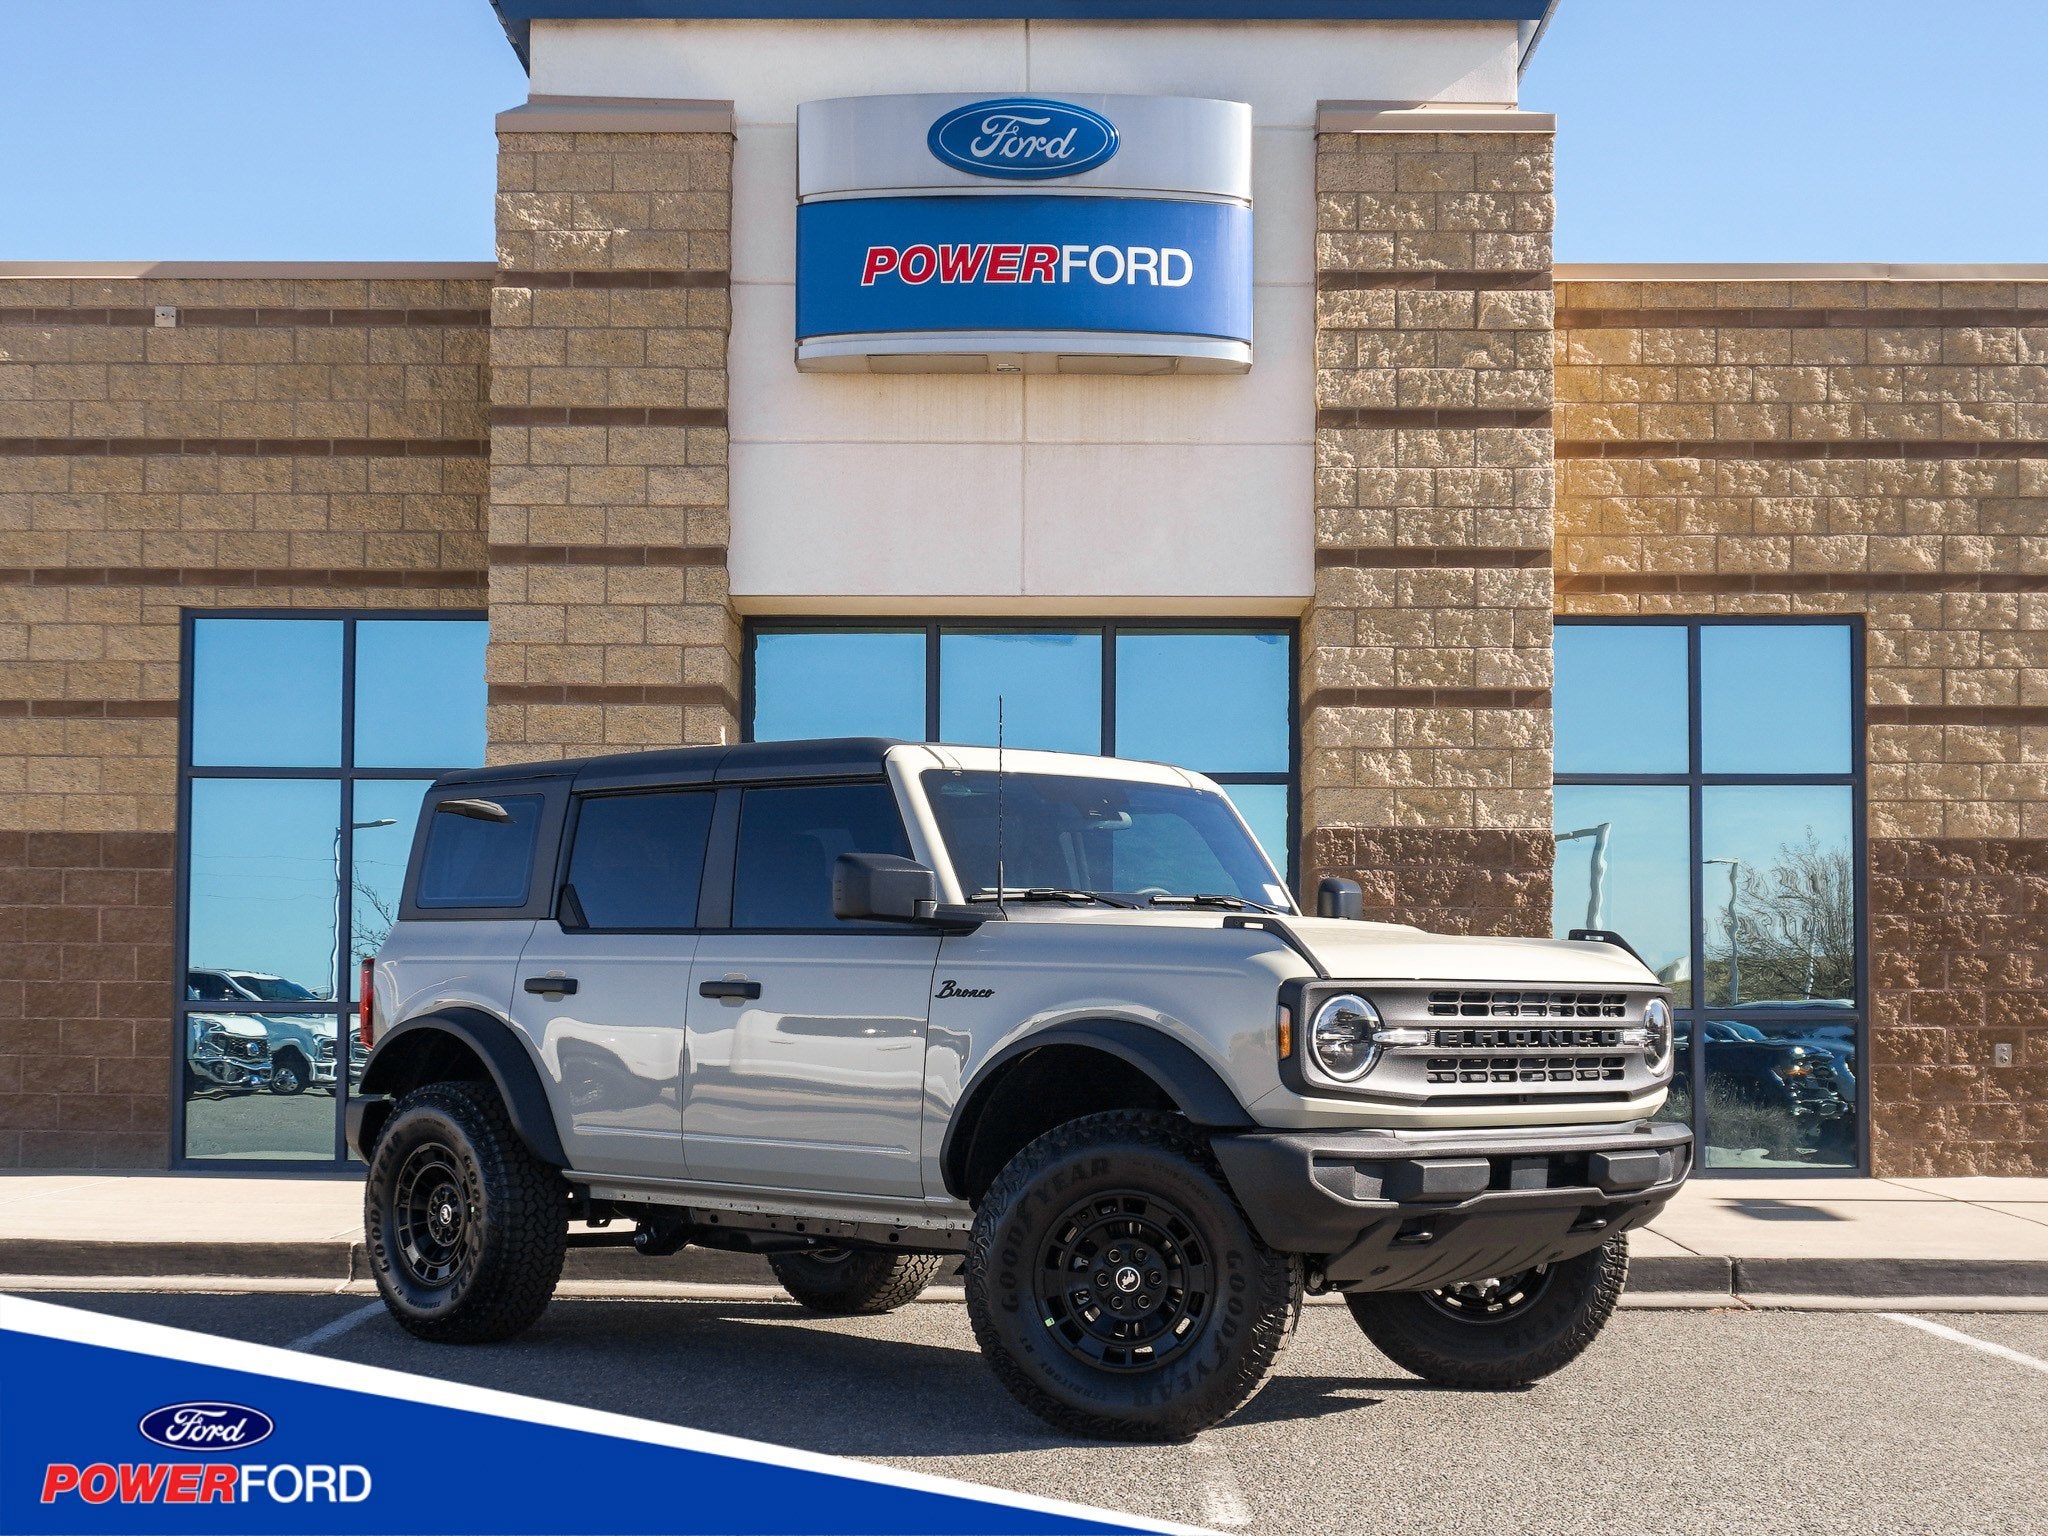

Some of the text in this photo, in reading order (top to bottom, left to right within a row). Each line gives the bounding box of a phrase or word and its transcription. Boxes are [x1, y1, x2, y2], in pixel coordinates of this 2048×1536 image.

[970, 114, 1078, 159] Ford
[934, 979, 996, 999] Bronco
[1438, 1030, 1620, 1048] BRONCO
